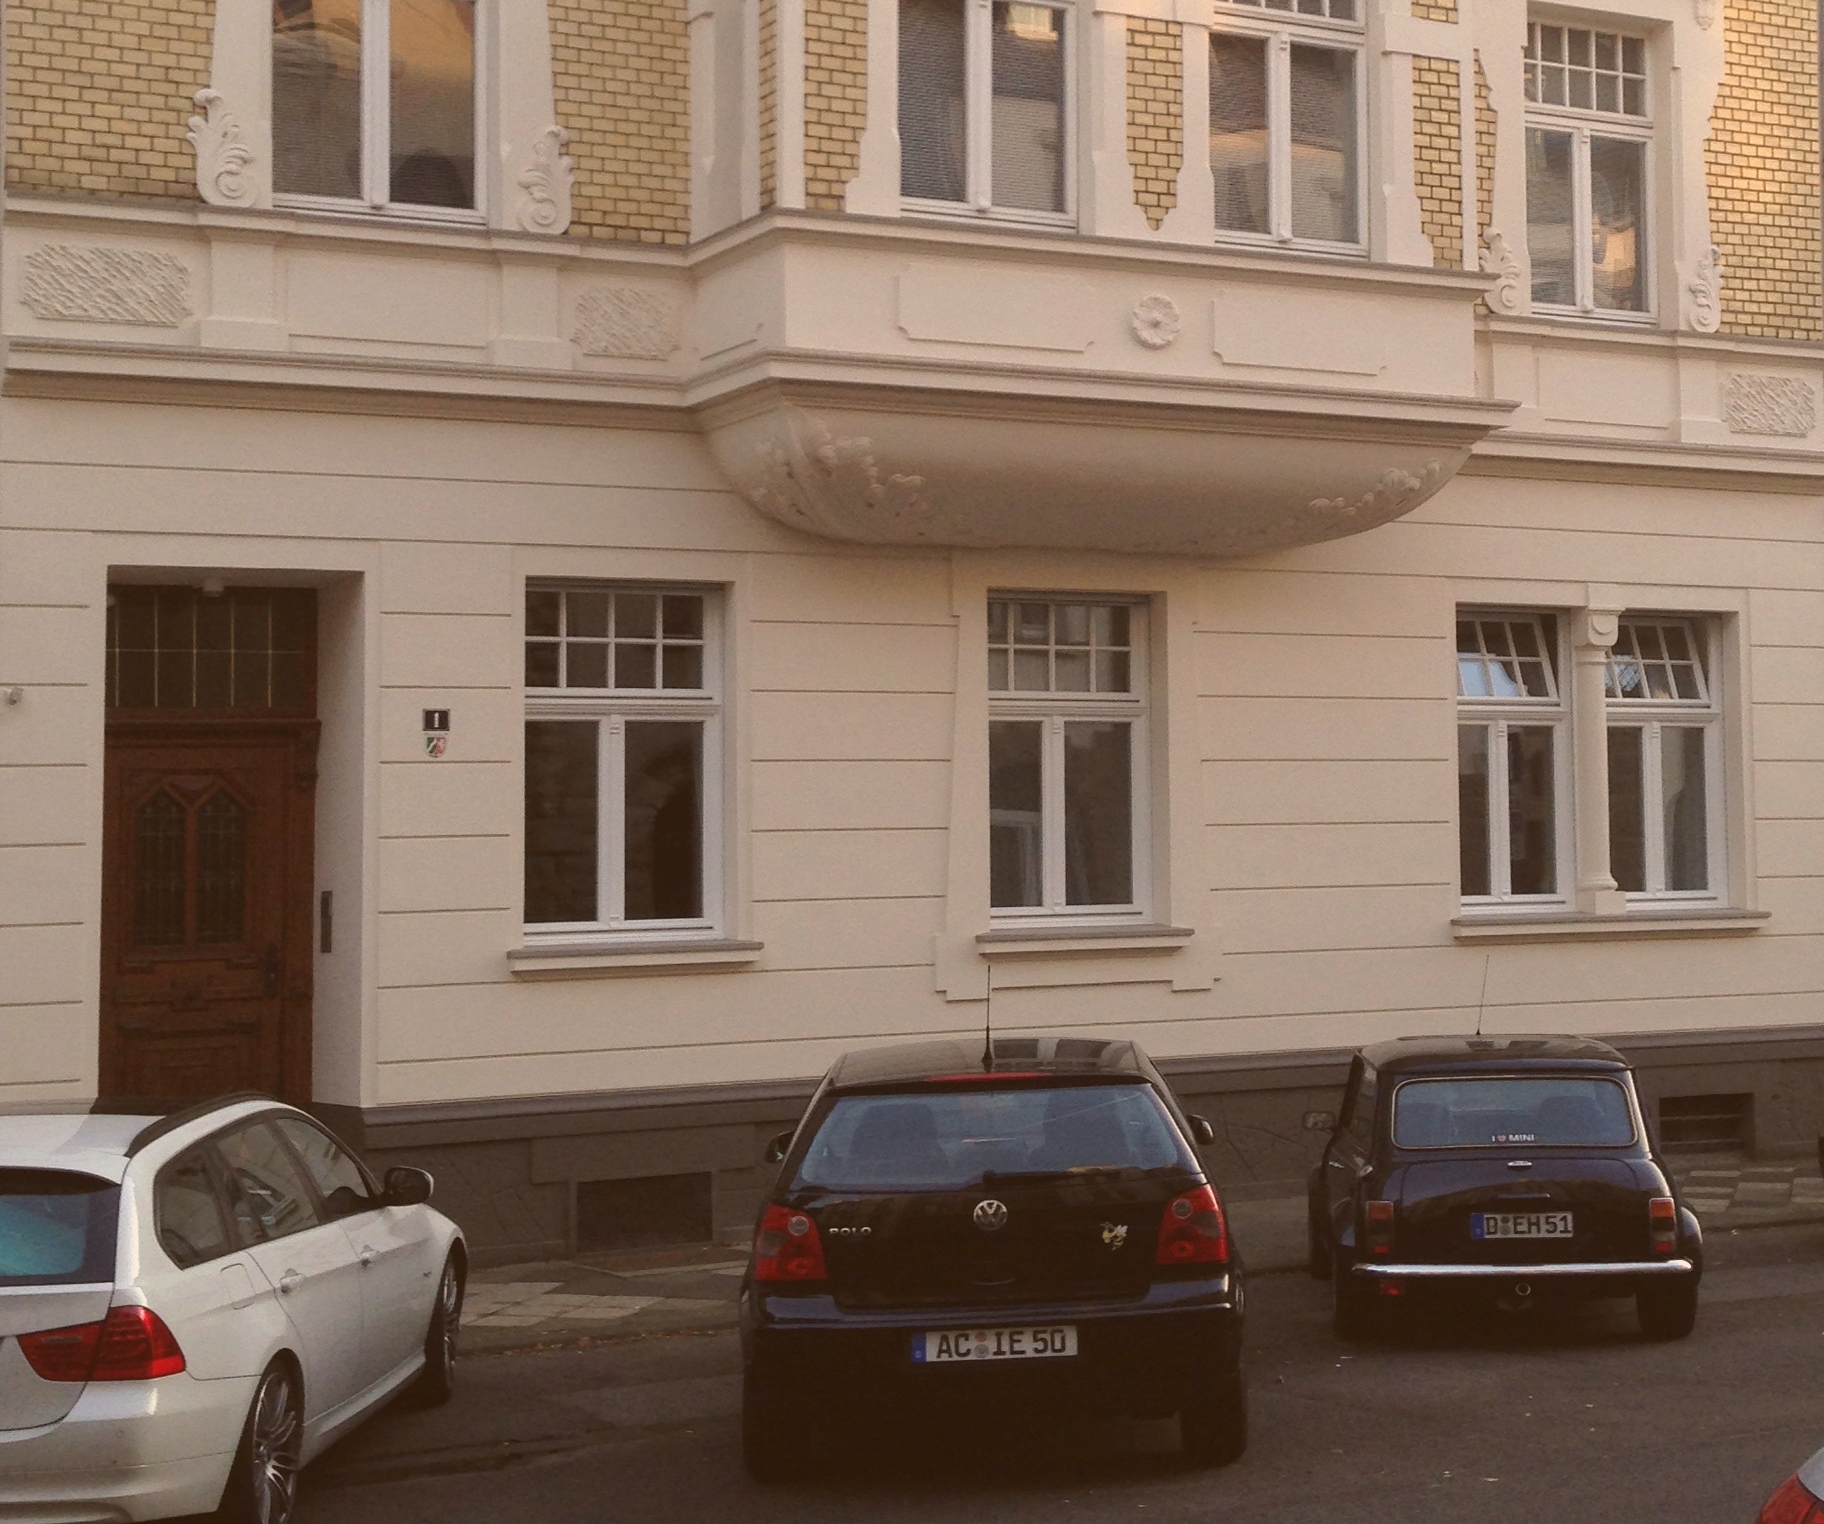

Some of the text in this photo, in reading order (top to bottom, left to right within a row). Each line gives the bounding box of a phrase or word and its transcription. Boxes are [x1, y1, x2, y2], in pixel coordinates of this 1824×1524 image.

[433, 711, 440, 728] 1
[1508, 1134, 1535, 1142] MINI
[936, 1333, 972, 1359] AC
